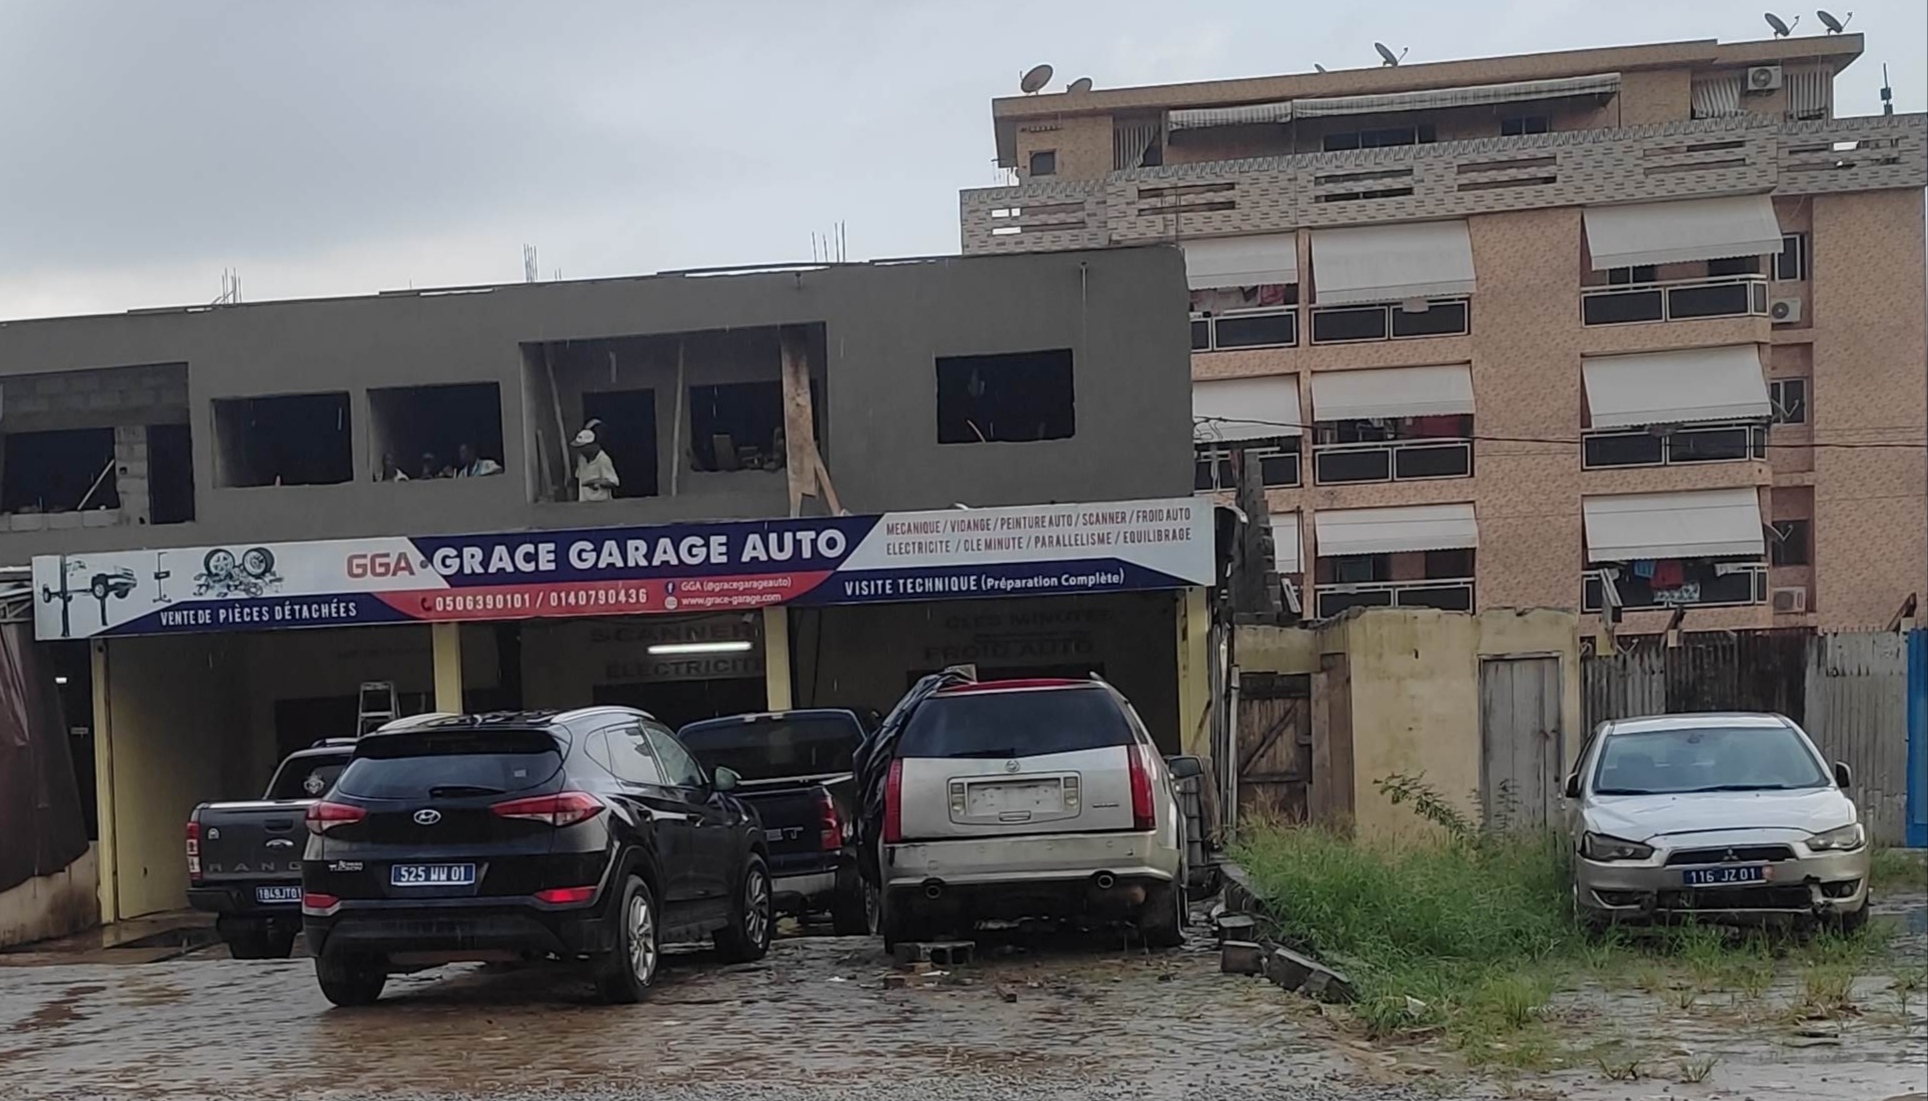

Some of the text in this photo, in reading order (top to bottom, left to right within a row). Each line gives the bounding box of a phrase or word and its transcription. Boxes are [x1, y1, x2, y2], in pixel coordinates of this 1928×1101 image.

[886, 521, 941, 536] MECANIQUE
[949, 519, 991, 533] VIDANGE
[1000, 516, 1047, 531] PEINTURE
[1047, 514, 1073, 528] AUTO
[1082, 511, 1127, 526] SCANNER
[1135, 509, 1164, 523] FROID
[1165, 508, 1191, 522] AUTO
[432, 528, 847, 576] GRACE GARAGE AUTO
[886, 541, 950, 556] ELECTRICITE
[984, 536, 1023, 551] MINUTE
[1034, 531, 1112, 548] PARALLELISME
[1123, 528, 1192, 544] EQUILIBRAGE
[346, 551, 417, 579] GGA
[681, 581, 701, 591] GGA
[844, 567, 1125, 596] VISITE TECHNIQUE (Préparation Complète)
[160, 599, 358, 627] VENTE DE PIÈCES DÉTACHÉES
[434, 592, 531, 612] 0506390101
[549, 588, 648, 608] 0140790436
[681, 593, 782, 607] www.grace-garage.com
[400, 866, 425, 883] 525
[450, 865, 466, 881] 01
[1691, 868, 1756, 884] 116 JZ 01
